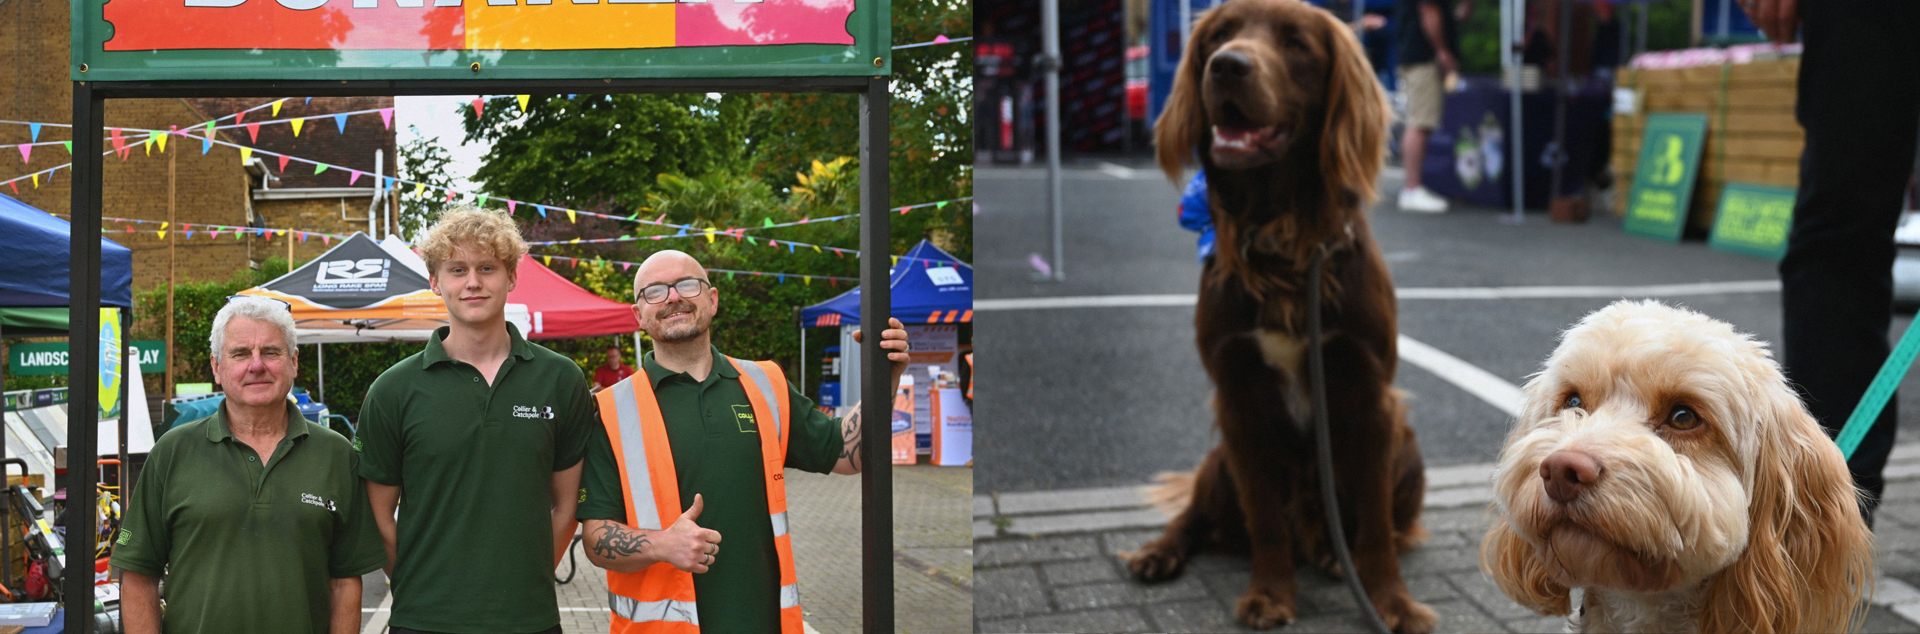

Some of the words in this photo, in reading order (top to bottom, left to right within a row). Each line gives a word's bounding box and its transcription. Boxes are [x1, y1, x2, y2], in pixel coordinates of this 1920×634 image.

[20, 352, 69, 366] LANDSC
[513, 411, 539, 419] Catchpole
[301, 497, 325, 507] Catchpole
